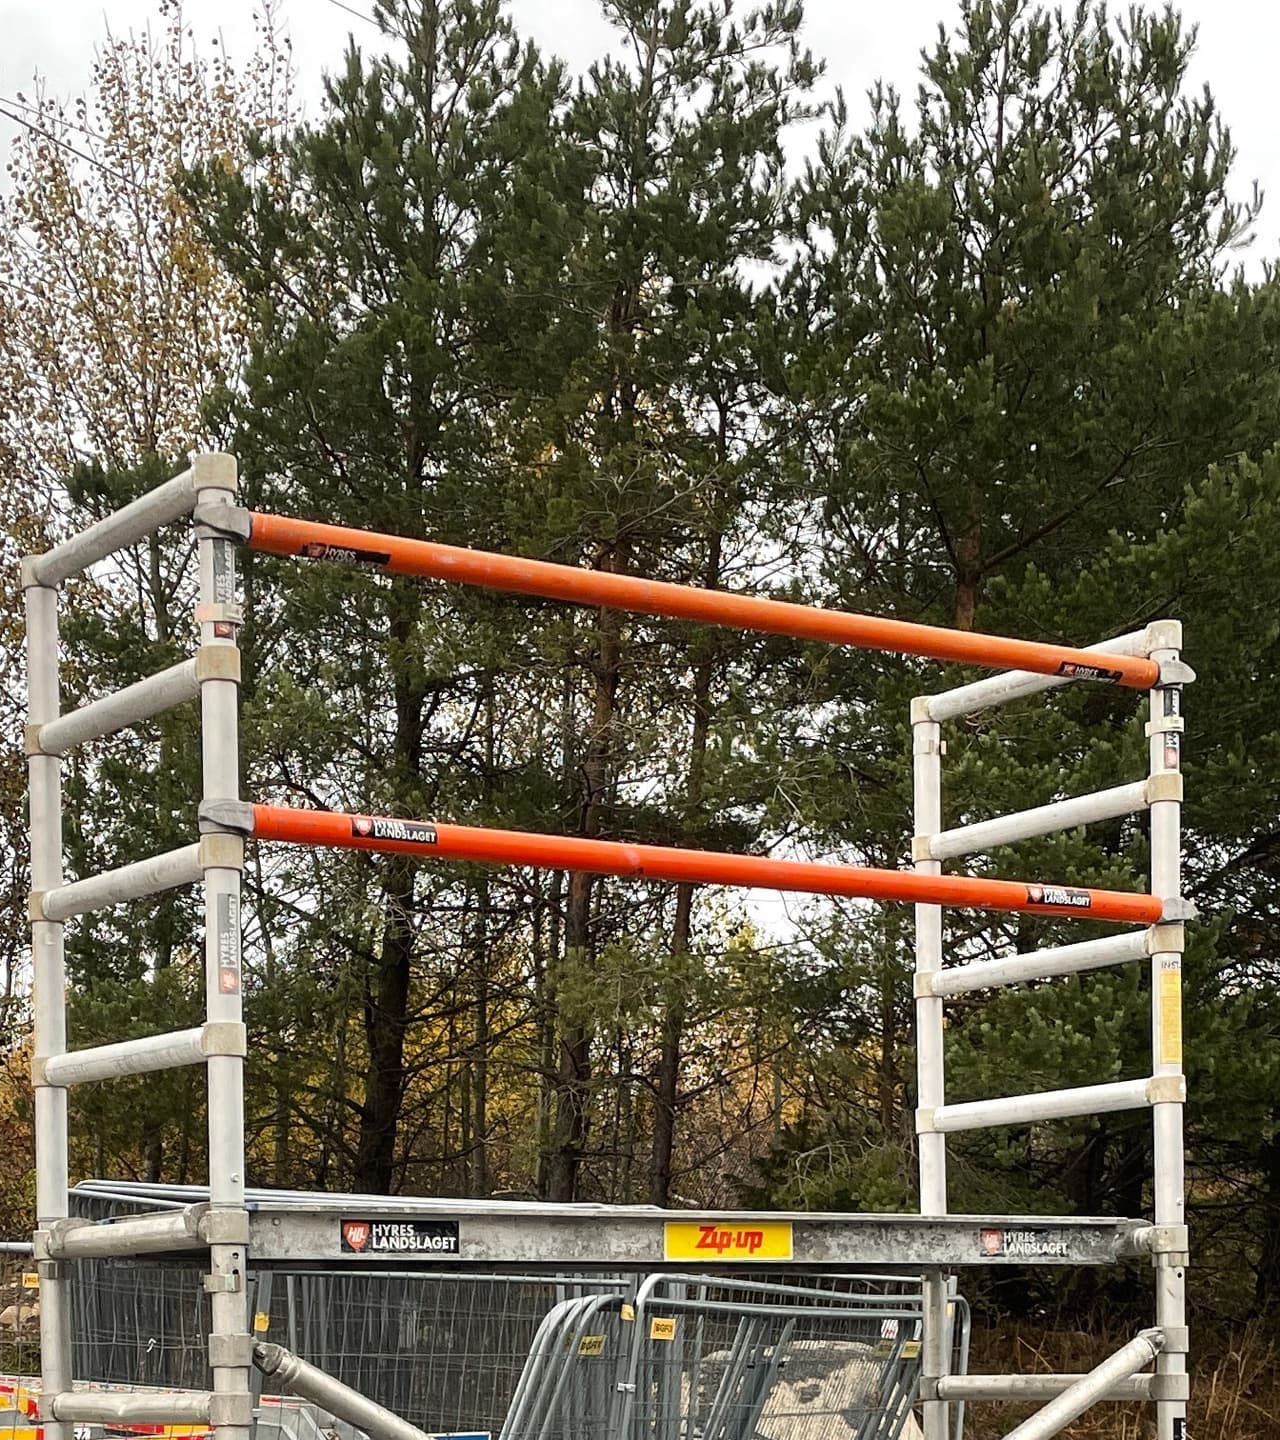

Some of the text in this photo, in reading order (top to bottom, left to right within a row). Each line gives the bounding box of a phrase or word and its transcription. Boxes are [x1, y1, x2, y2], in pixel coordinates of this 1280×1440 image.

[374, 824, 437, 842] LANDSLAGET
[372, 1224, 415, 1236] HYRES
[372, 1236, 457, 1249] LANDSLAGET
[1003, 1231, 1035, 1242] HYRES
[1003, 1242, 1067, 1254] LANDSLAGET
